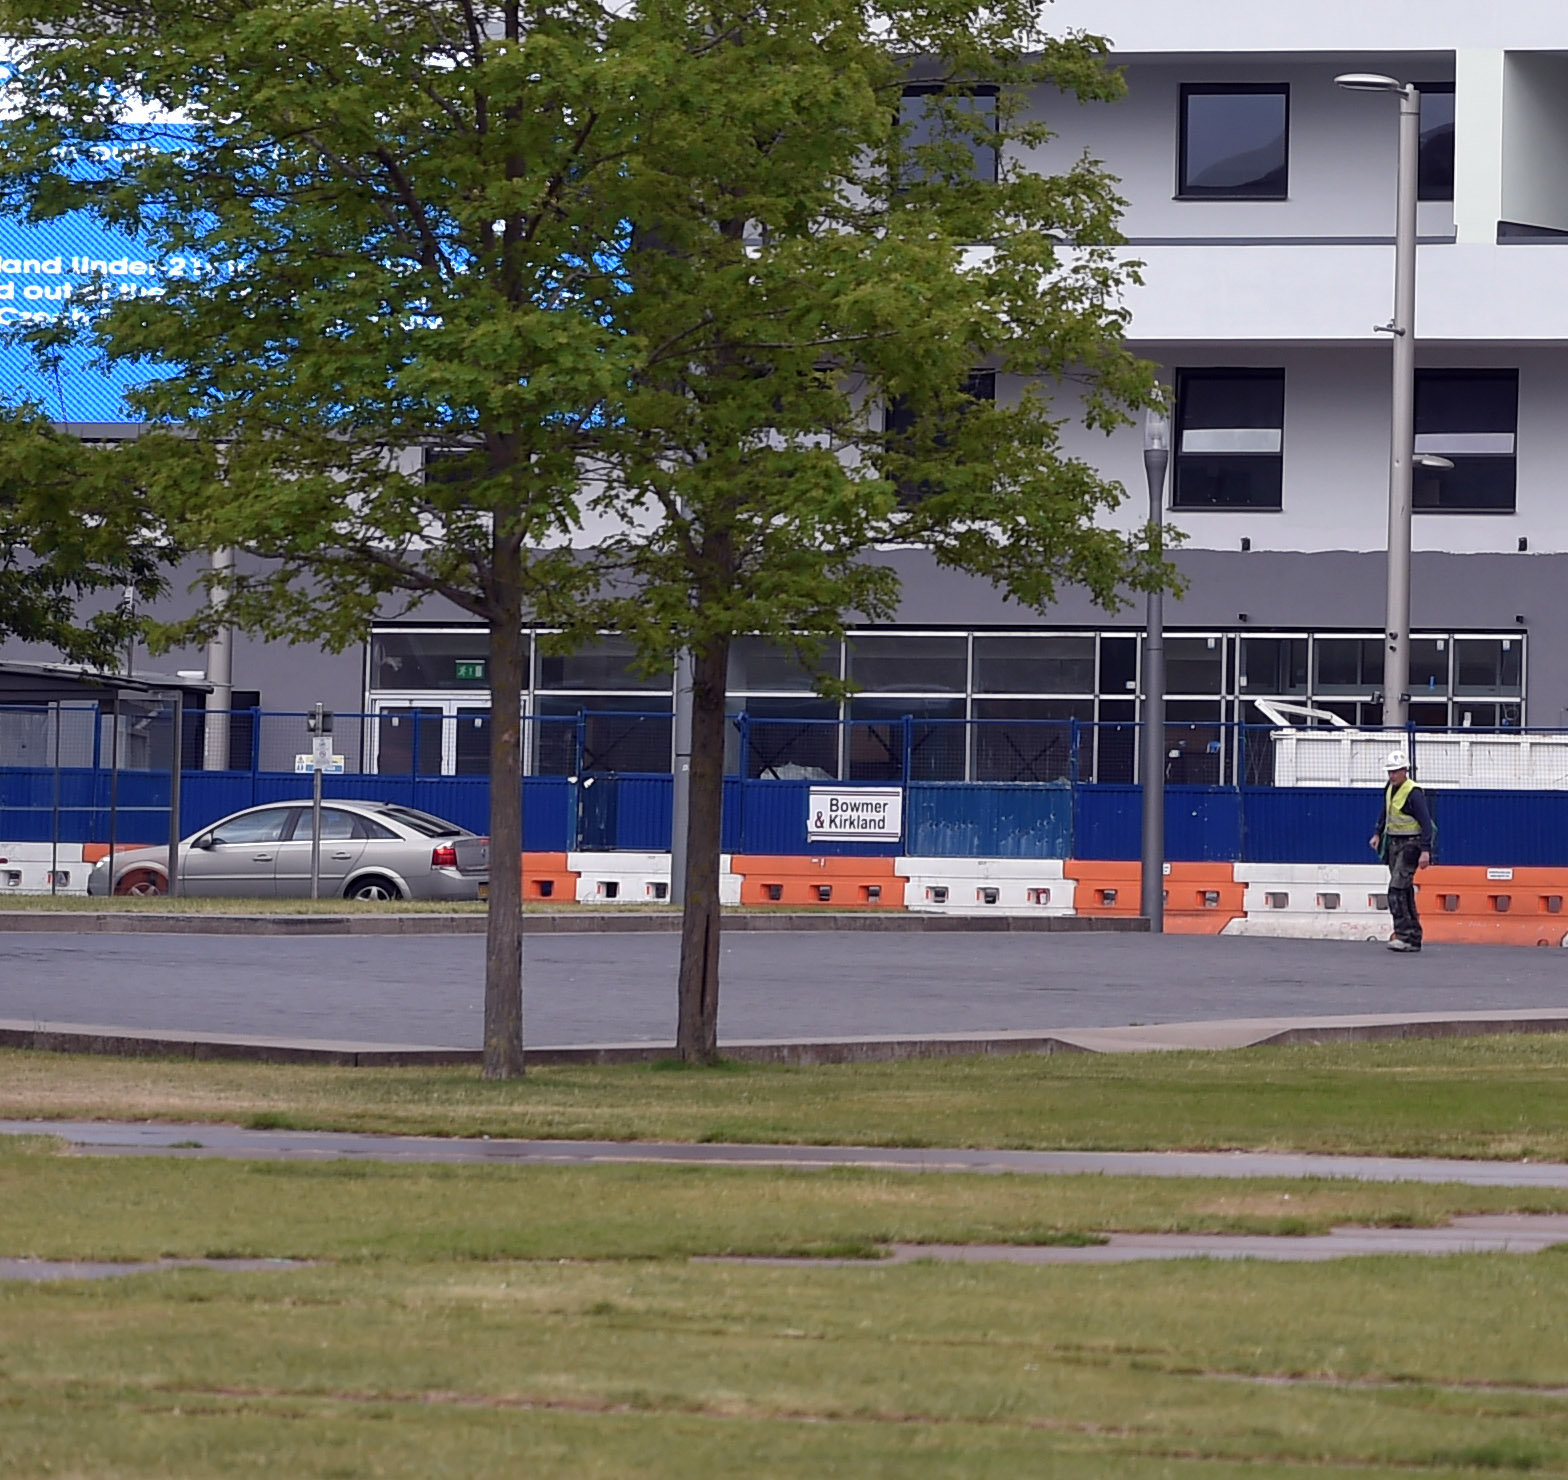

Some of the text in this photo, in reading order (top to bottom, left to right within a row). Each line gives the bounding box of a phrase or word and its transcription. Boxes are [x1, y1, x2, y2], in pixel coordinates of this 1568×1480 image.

[23, 282, 73, 300] out
[829, 797, 888, 813] Bowmer
[814, 811, 886, 830] & Kirkland
